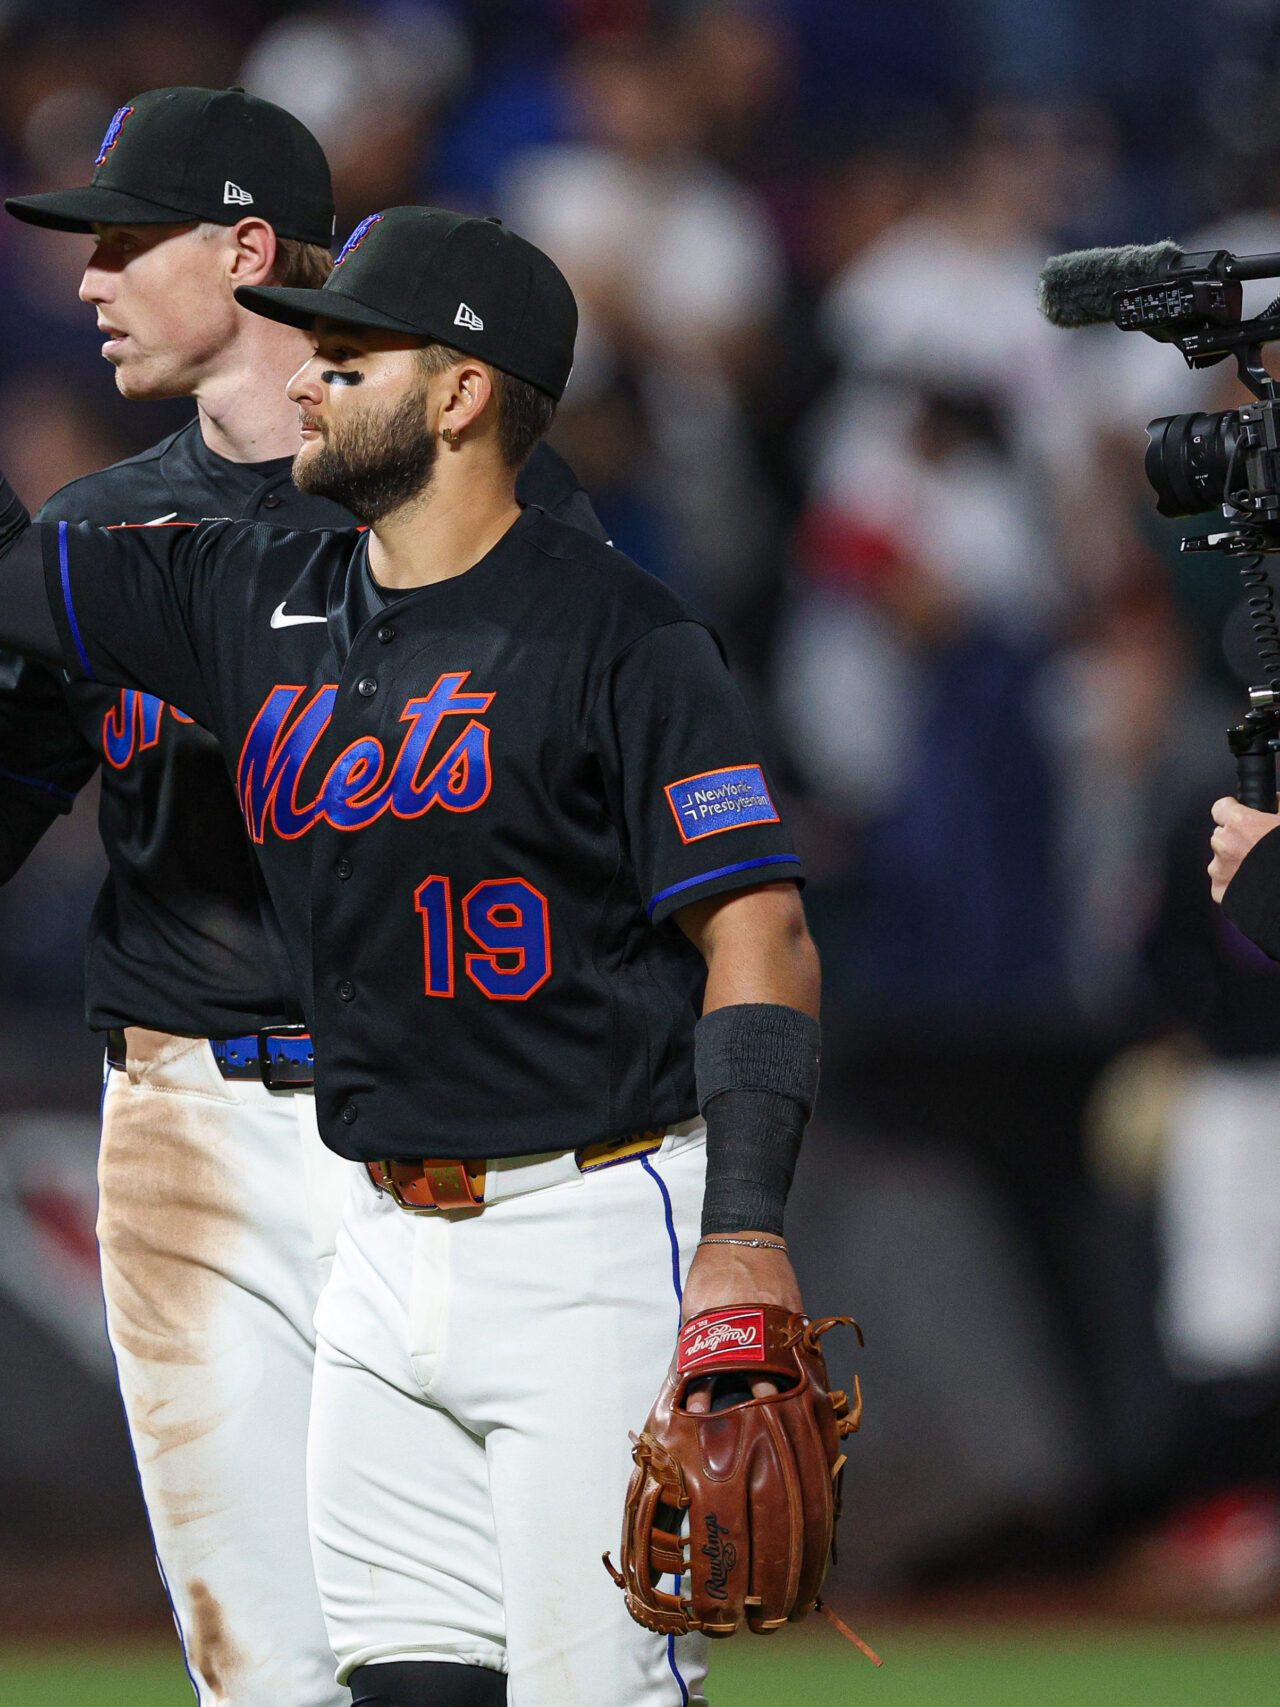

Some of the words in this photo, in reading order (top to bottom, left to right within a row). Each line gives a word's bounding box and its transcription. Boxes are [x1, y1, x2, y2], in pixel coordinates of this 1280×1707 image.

[235, 671, 496, 844] Mets
[413, 874, 552, 1001] 19
[685, 1324, 756, 1356] Rawlings
[702, 1512, 736, 1600] Rawlings
